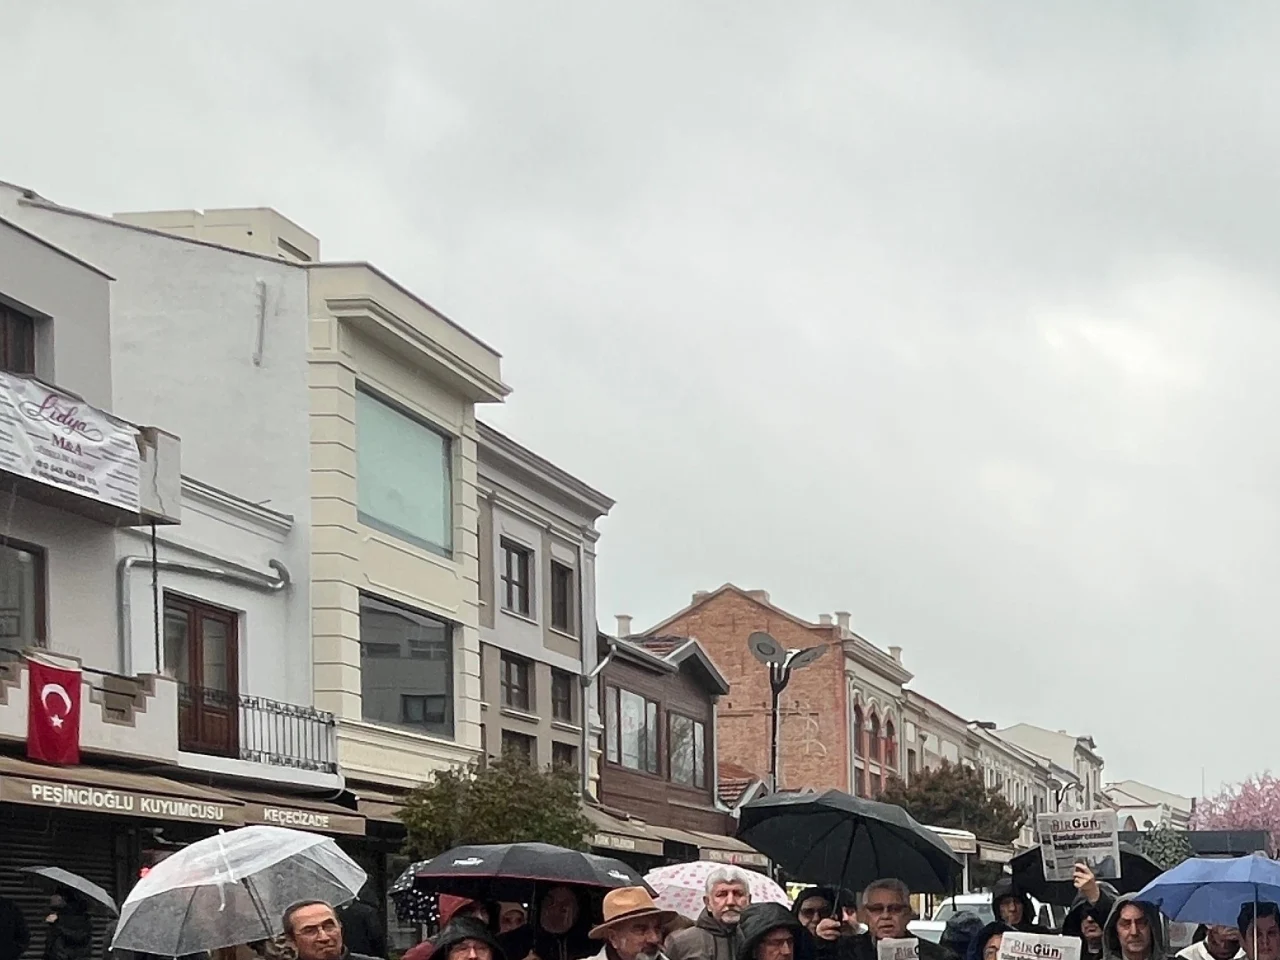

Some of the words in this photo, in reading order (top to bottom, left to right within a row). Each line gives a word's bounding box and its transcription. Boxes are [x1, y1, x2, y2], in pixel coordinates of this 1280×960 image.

[19, 394, 104, 442] Lidya
[52, 433, 83, 456] M&A
[31, 784, 134, 810] PEŞİNCİOĞLU
[140, 797, 224, 821] KUYUMCUSU
[264, 808, 330, 829] KEÇECİZADE
